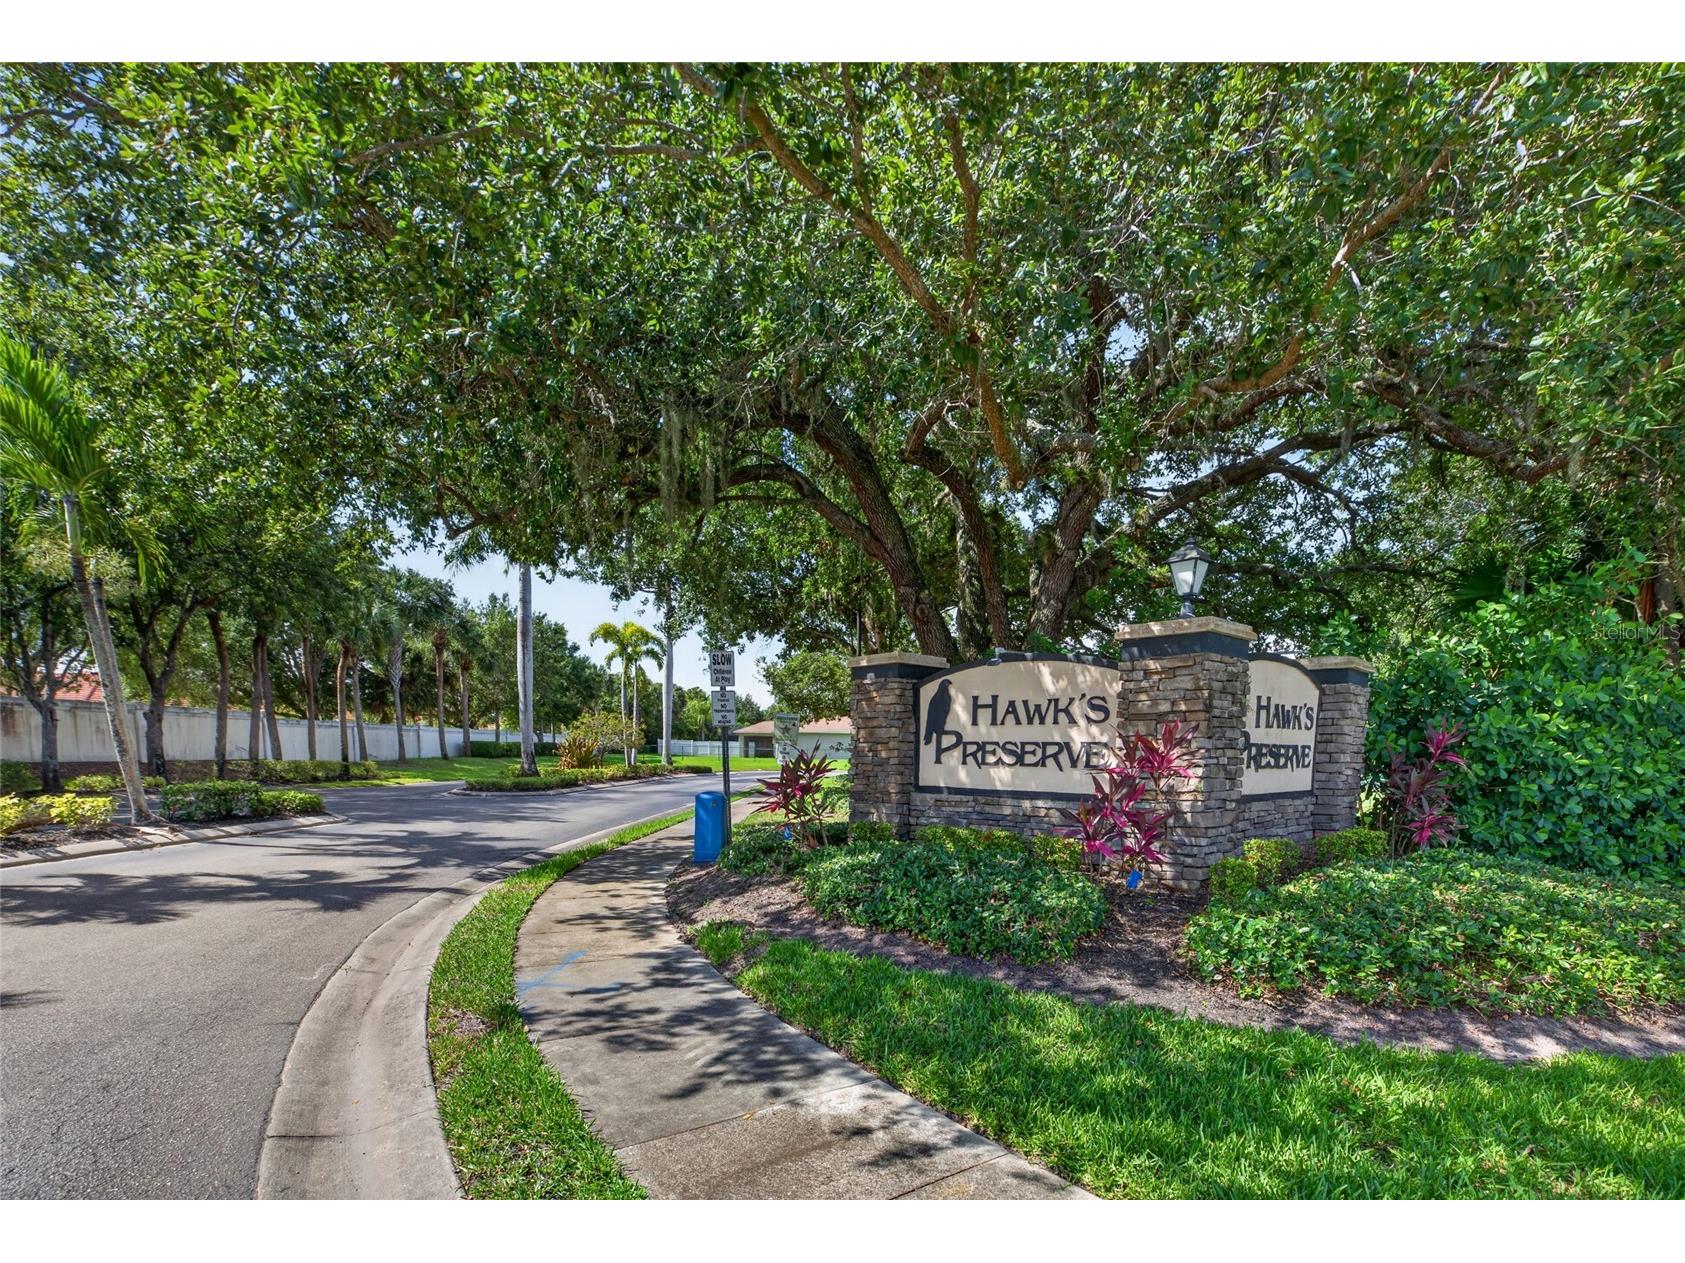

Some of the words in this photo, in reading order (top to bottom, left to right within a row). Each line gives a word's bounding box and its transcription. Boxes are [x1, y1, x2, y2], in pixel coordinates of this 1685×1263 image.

[712, 653, 731, 665] SLOW
[971, 693, 1110, 726] HAWK'S
[1254, 695, 1315, 731] HAWK'S
[934, 730, 1109, 772] PRESERVE
